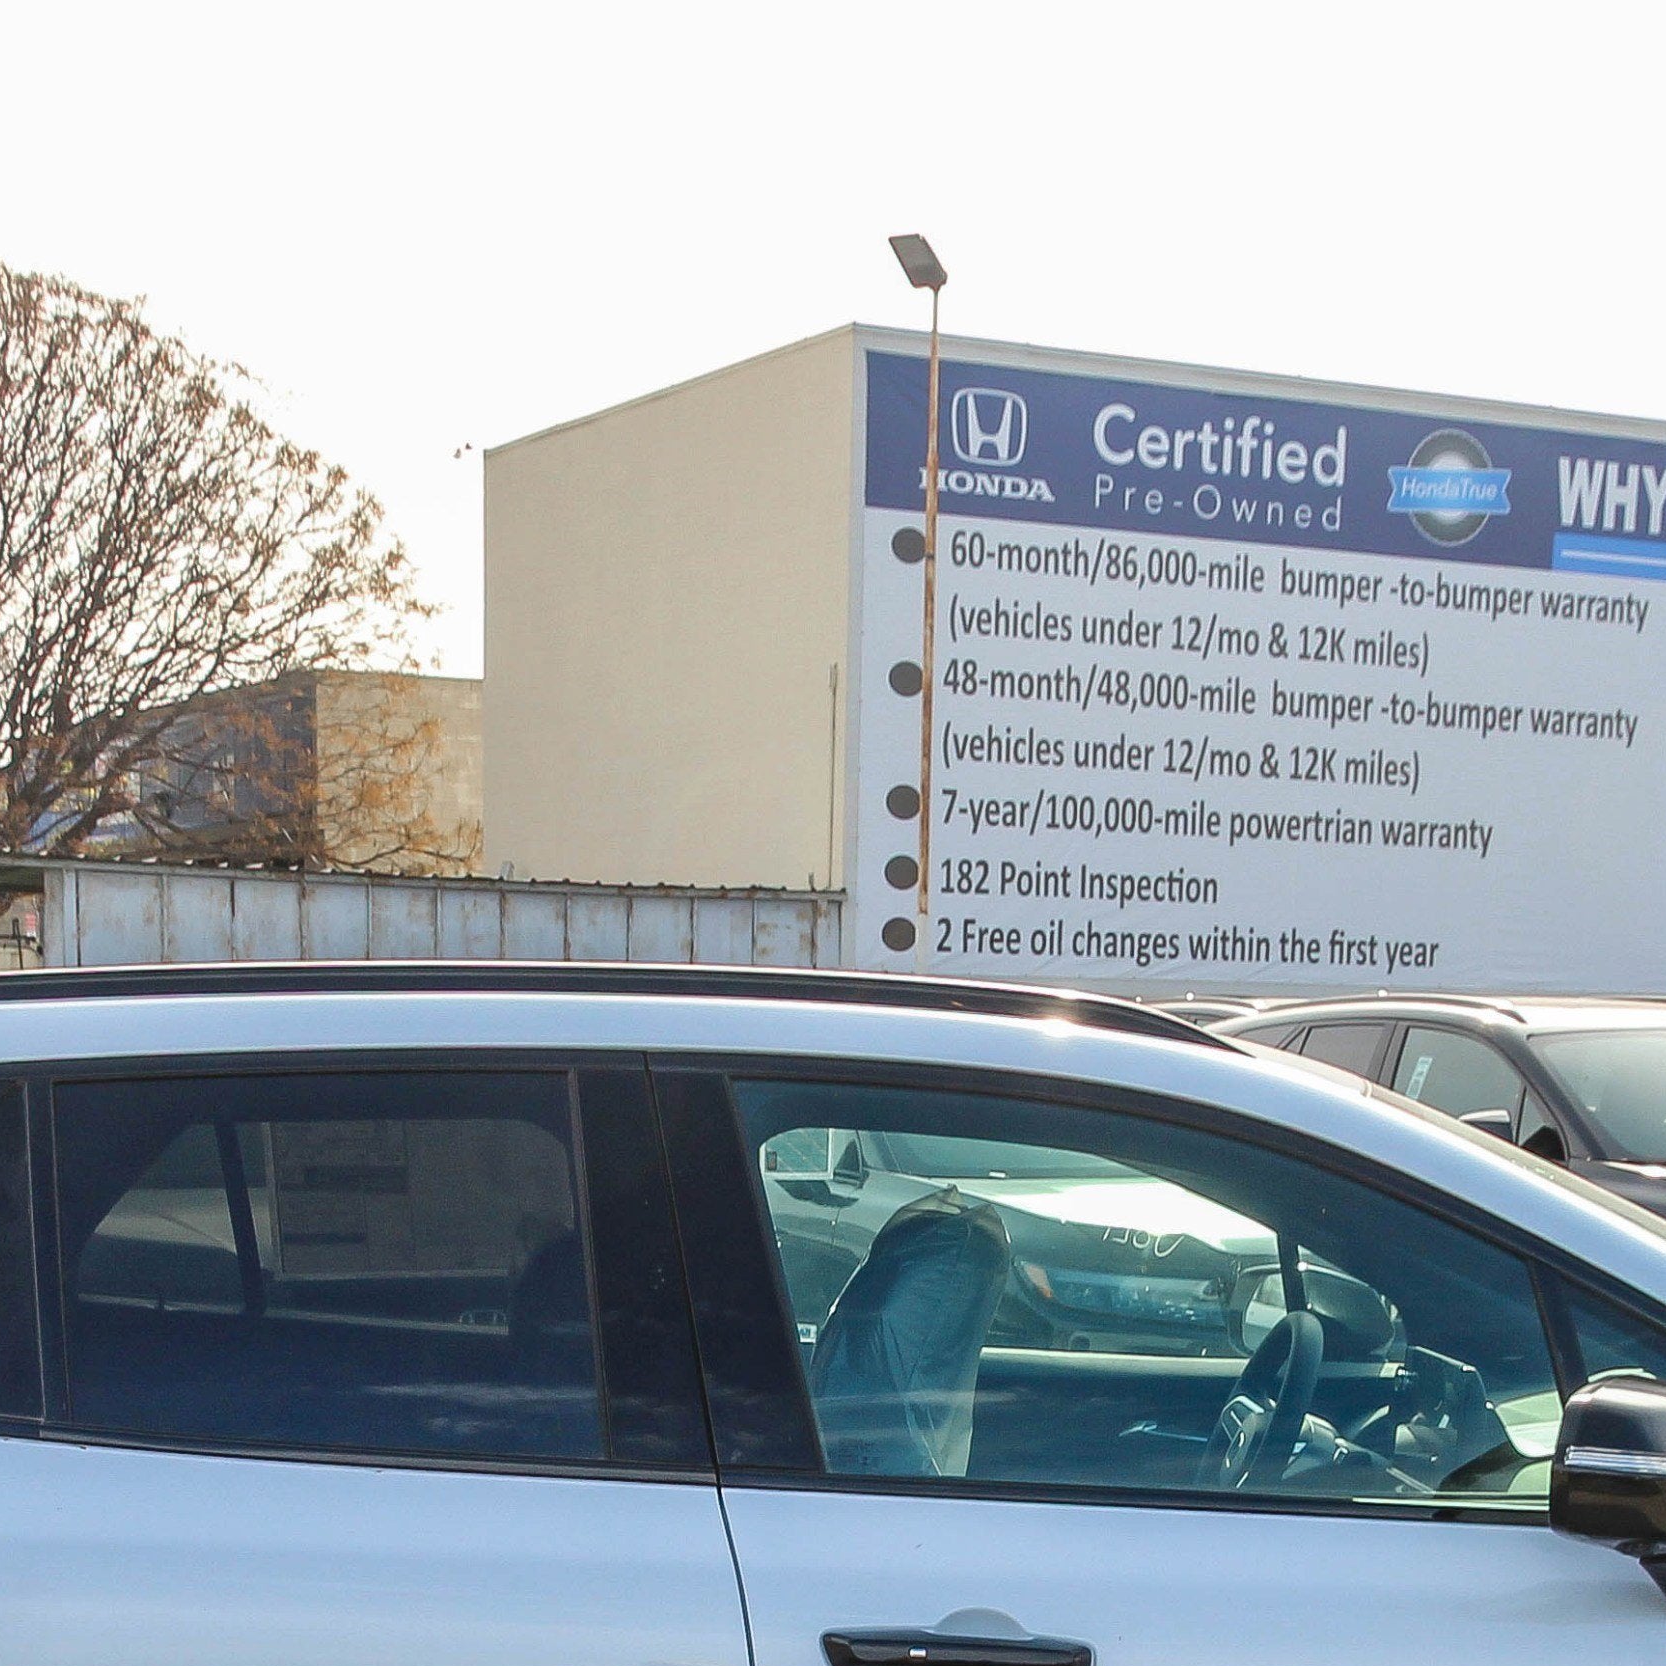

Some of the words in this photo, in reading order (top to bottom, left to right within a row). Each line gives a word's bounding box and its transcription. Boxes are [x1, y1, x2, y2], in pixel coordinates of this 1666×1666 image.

[1093, 404, 1347, 487] Certified
[919, 466, 1056, 503] HONDA
[1094, 473, 1342, 532] Pre-Owned
[1401, 475, 1497, 499] HondaTrue
[951, 530, 1265, 594] 60-month/86,000-mile
[1280, 557, 1383, 610] bumper
[1389, 571, 1534, 623] -to-bumper
[1540, 591, 1650, 634] warranty
[949, 593, 1073, 643] (vehicles
[1082, 608, 1163, 649] under
[1171, 612, 1260, 661] 12/mo
[1268, 621, 1289, 659] &
[1298, 625, 1346, 663] 12K
[1353, 630, 1429, 679] miles)
[943, 658, 1256, 715] 48-month/48,000-mile
[1272, 678, 1374, 730] bumper
[1380, 691, 1524, 739] -to-bumper
[1530, 708, 1639, 749] warranty
[942, 720, 1065, 769] (vehicles
[1074, 732, 1155, 772] under
[1163, 735, 1251, 782] 12/mo
[1259, 743, 1280, 779] &
[1289, 745, 1337, 783] 12K
[1344, 749, 1420, 796] miles)
[941, 788, 1221, 839] 7-year/100,000-mile
[1229, 808, 1373, 847] powertrian
[1381, 818, 1494, 859] warranty
[940, 858, 990, 895] 182
[1000, 860, 1072, 899] Point
[1080, 863, 1218, 910] Inspection
[936, 917, 952, 953] 2
[962, 918, 1021, 955] Free
[1030, 919, 1064, 957] oil
[1072, 919, 1180, 968] changes
[1188, 925, 1271, 963] within
[1279, 927, 1321, 965] the
[1328, 929, 1378, 966] first
[1385, 941, 1440, 975] year
